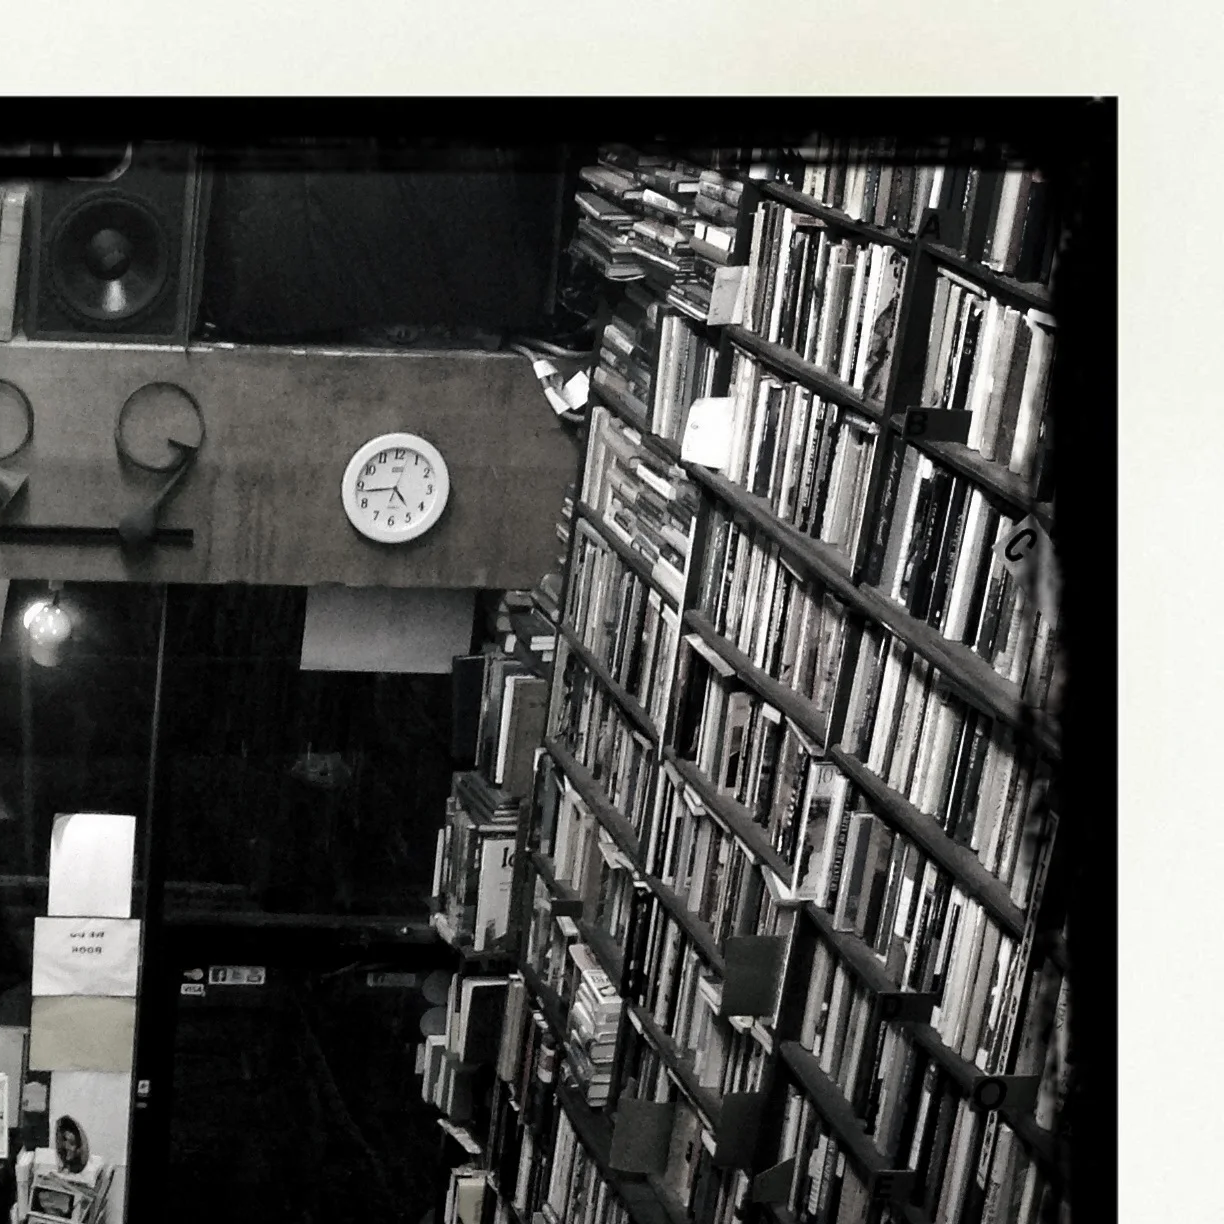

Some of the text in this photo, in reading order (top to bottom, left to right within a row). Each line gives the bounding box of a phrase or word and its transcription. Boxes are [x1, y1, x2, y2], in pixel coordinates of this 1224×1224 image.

[379, 452, 387, 463] 11
[395, 449, 406, 460] 12
[414, 455, 419, 465] 1
[365, 465, 376, 475] 10
[424, 468, 431, 478] 2
[357, 481, 364, 491] 9
[426, 485, 433, 494] 3
[361, 498, 368, 508] 8
[418, 501, 425, 511] 4
[373, 511, 379, 520] 7
[405, 513, 412, 523] 5
[388, 516, 395, 526] 6
[1004, 528, 1036, 562] C
